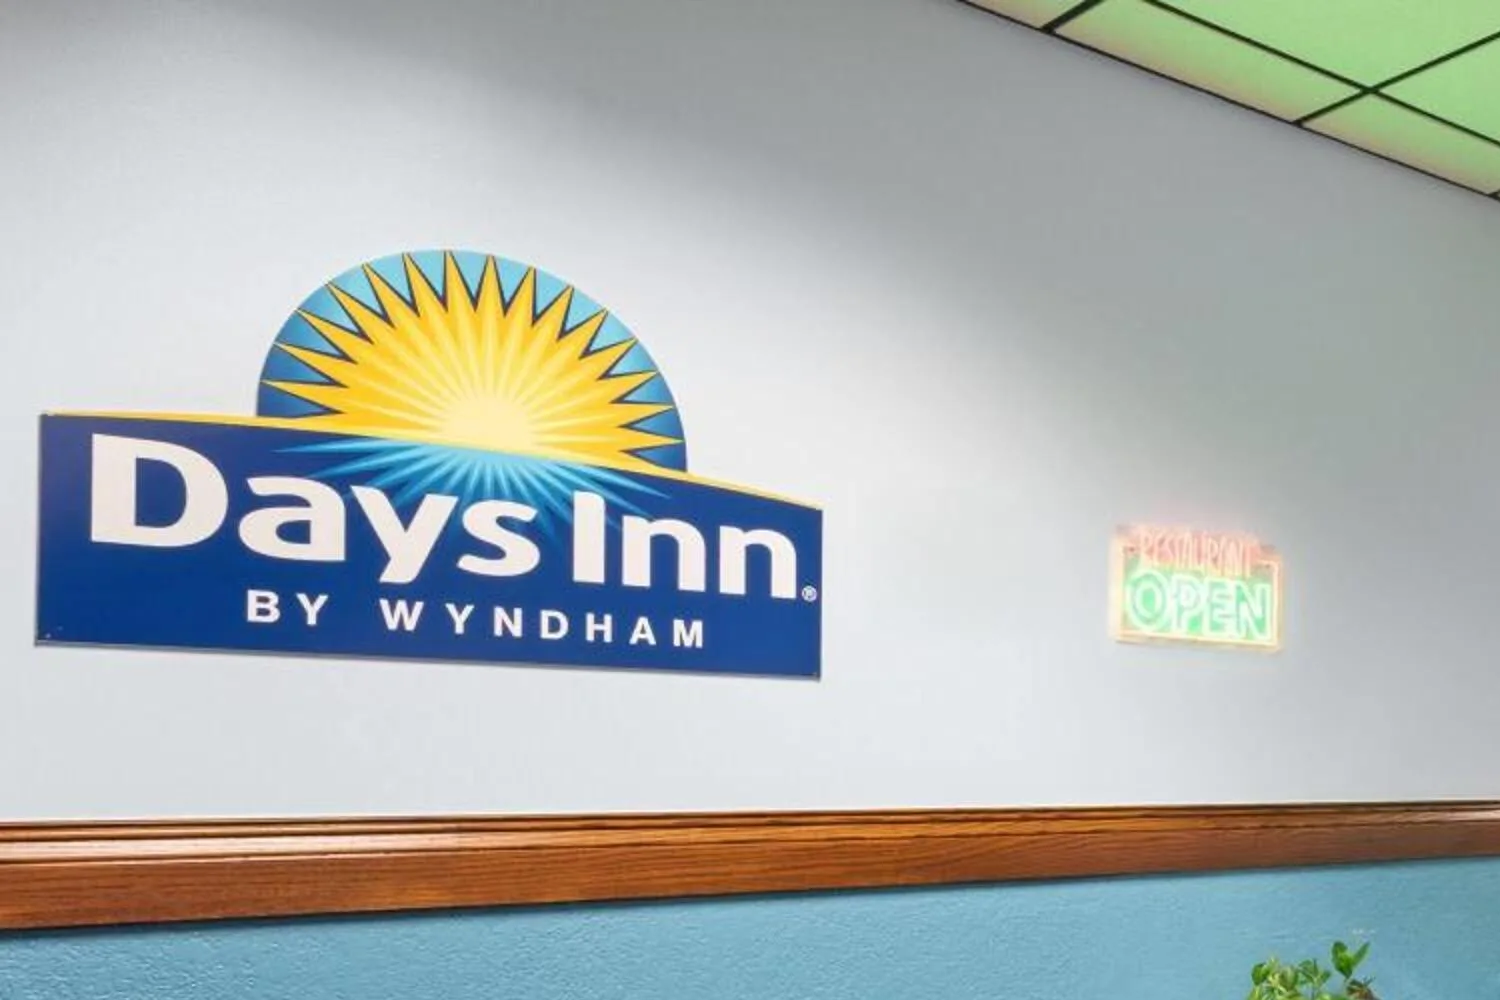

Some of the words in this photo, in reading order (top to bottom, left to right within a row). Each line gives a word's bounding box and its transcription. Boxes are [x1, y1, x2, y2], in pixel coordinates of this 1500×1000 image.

[90, 432, 541, 584] Days
[246, 588, 329, 626] BY
[380, 598, 705, 649] WYNDHAM
[1124, 567, 1272, 641] OPEN
